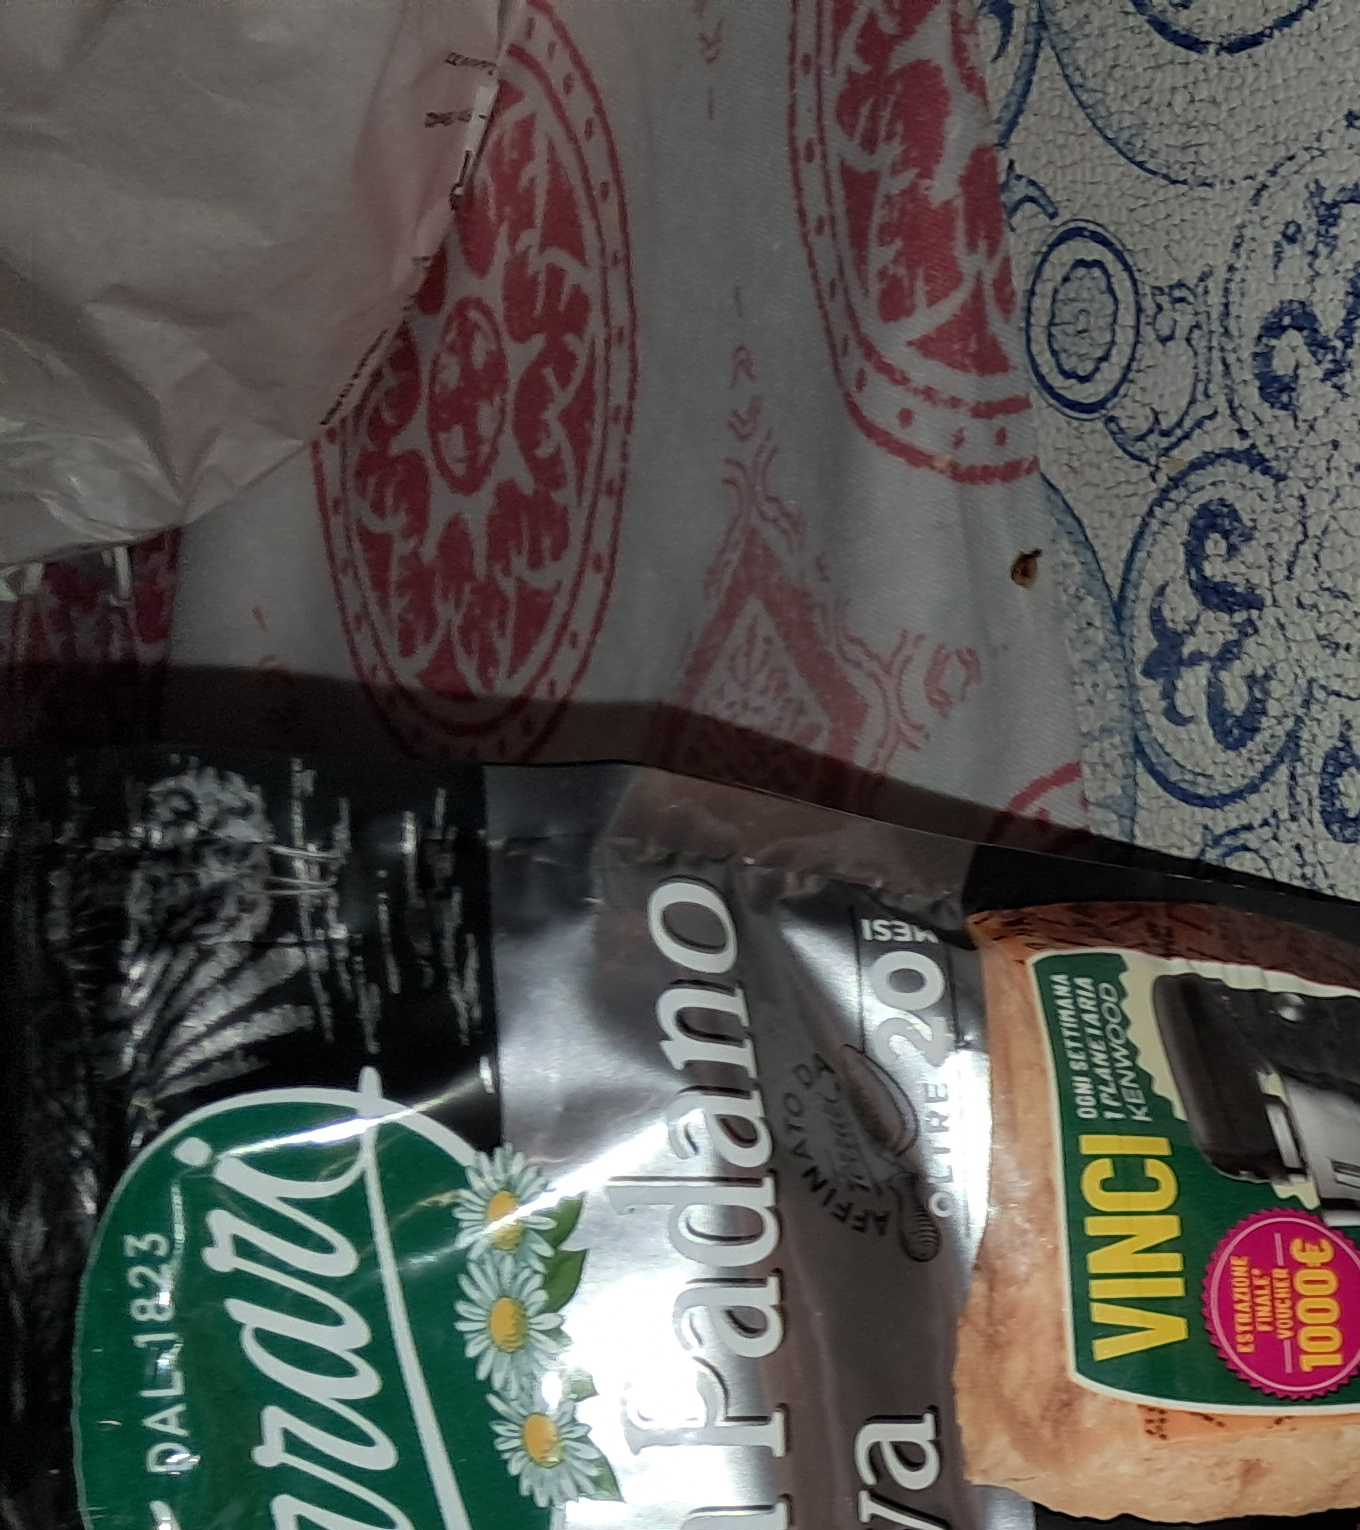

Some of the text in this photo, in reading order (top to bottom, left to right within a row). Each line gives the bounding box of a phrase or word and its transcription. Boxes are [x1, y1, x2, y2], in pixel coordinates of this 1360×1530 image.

[868, 950, 957, 1218] OLTRE 20
[1049, 974, 1098, 1119] OGNI SETTIMANA
[1073, 977, 1126, 1119] 1 PLANETARIA
[1098, 982, 1152, 1122] KENWOOD
[604, 878, 788, 1456] Padano
[783, 1093, 890, 1236] AFFINATO
[1078, 1134, 1189, 1361] VINCI
[1229, 1256, 1256, 1353] ESTRAZIONE
[1272, 1268, 1295, 1339] VOUCHER
[1289, 1237, 1344, 1372] 1000€
[123, 1233, 192, 1473] DAL 1823
